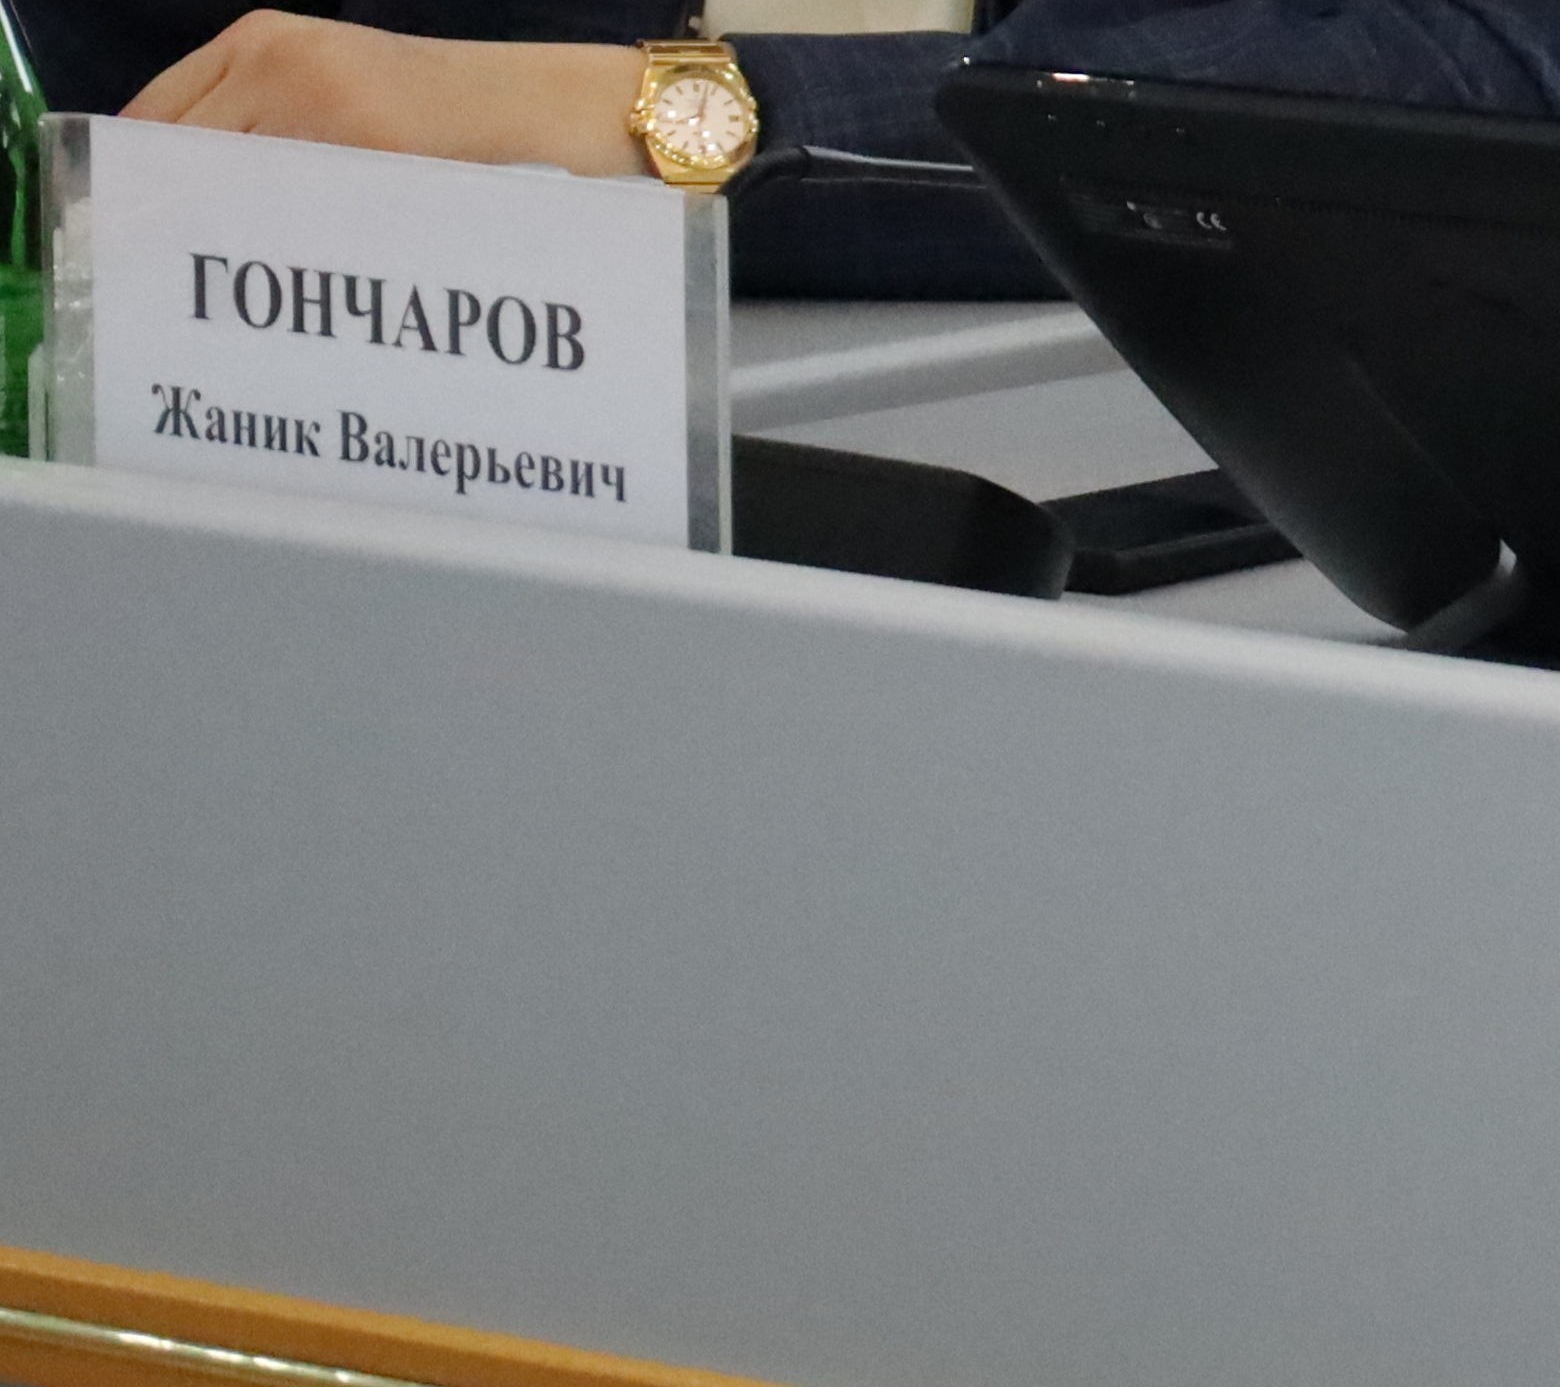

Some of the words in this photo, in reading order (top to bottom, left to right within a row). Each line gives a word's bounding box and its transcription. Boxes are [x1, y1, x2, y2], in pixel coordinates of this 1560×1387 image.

[189, 253, 587, 372] ГОНЧАРОВ
[151, 383, 321, 458] Жаник
[338, 410, 627, 503] Валерьевич
